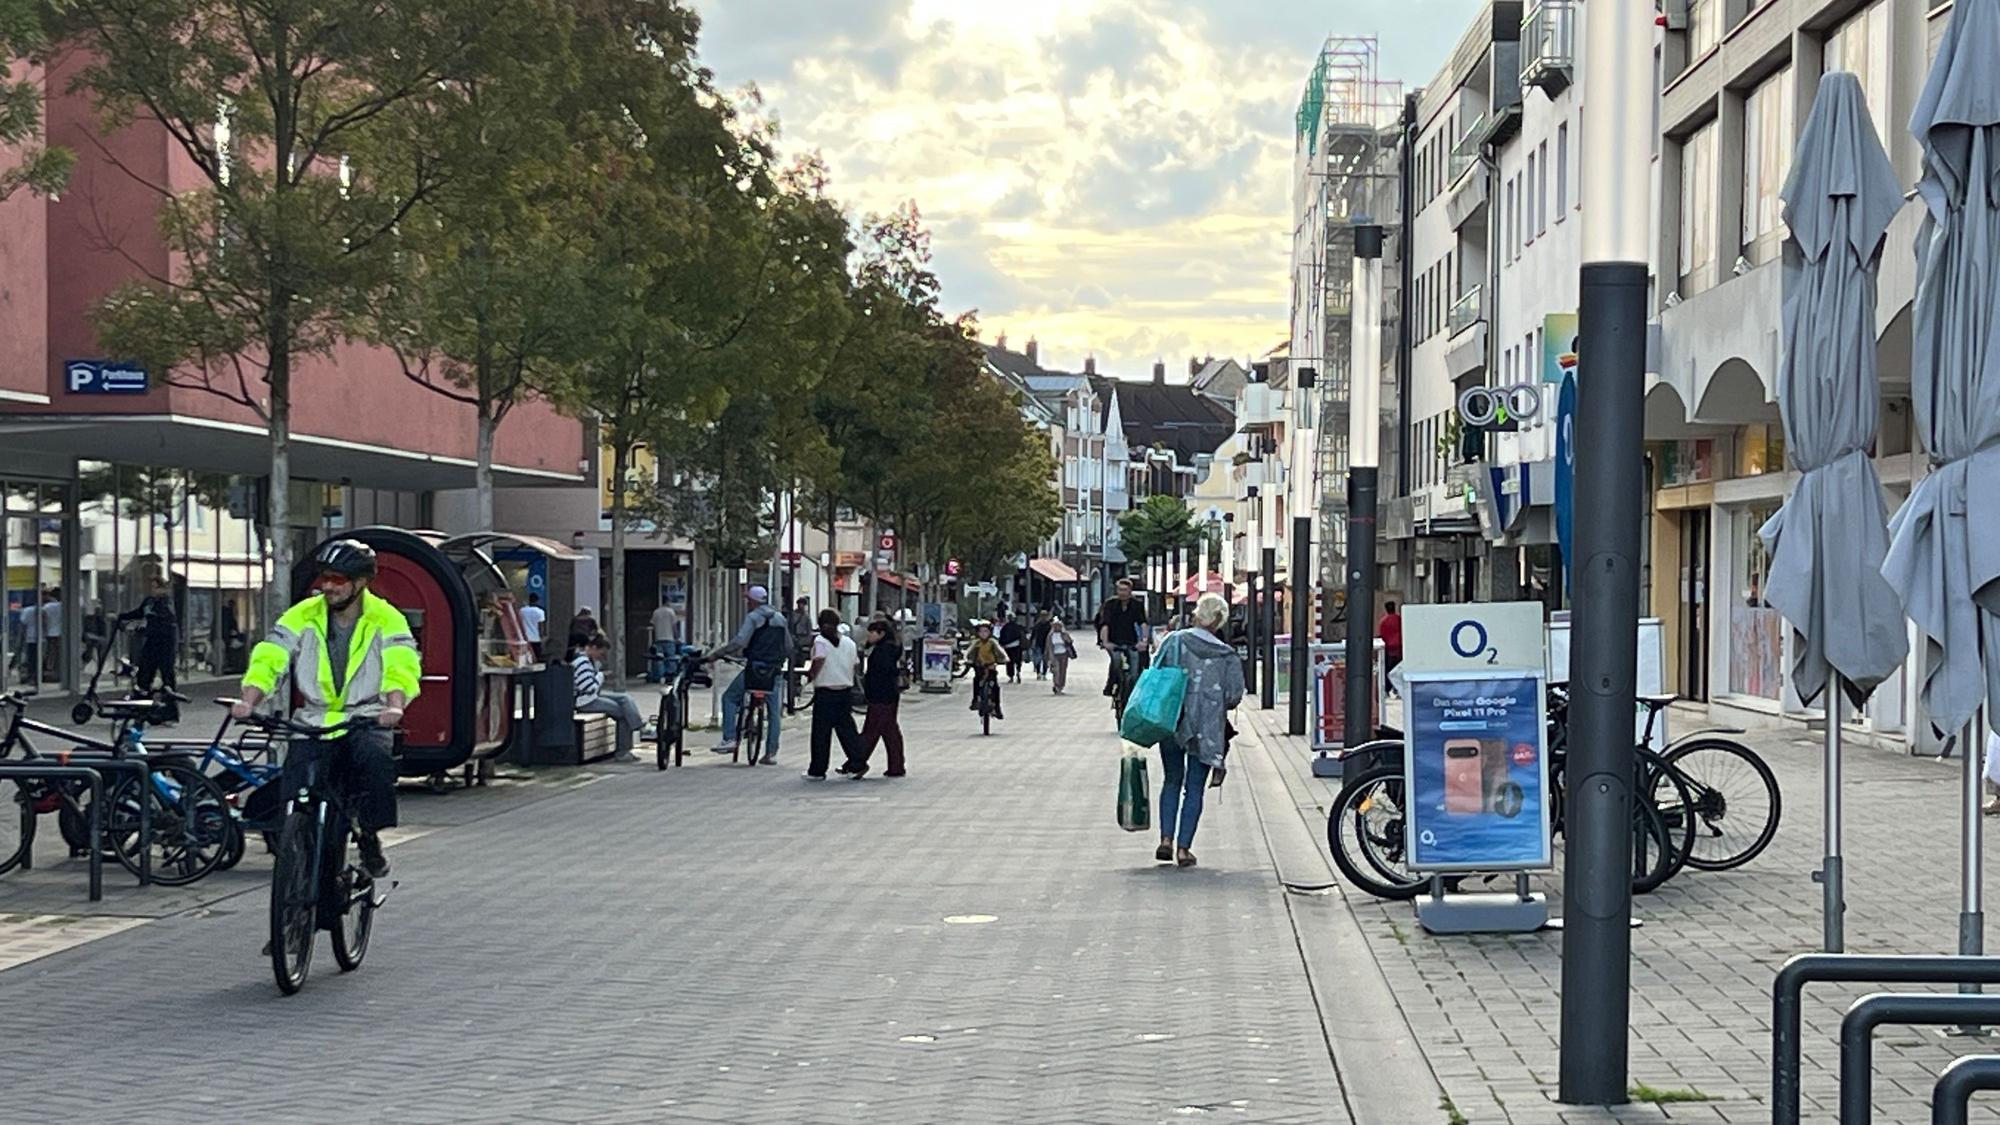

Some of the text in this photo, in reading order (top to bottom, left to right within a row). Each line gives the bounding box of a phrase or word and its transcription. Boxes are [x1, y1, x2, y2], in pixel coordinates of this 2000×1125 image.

[71, 369, 94, 391] P
[1443, 708, 1472, 717] Pixel
[1486, 707, 1507, 717] Pro
